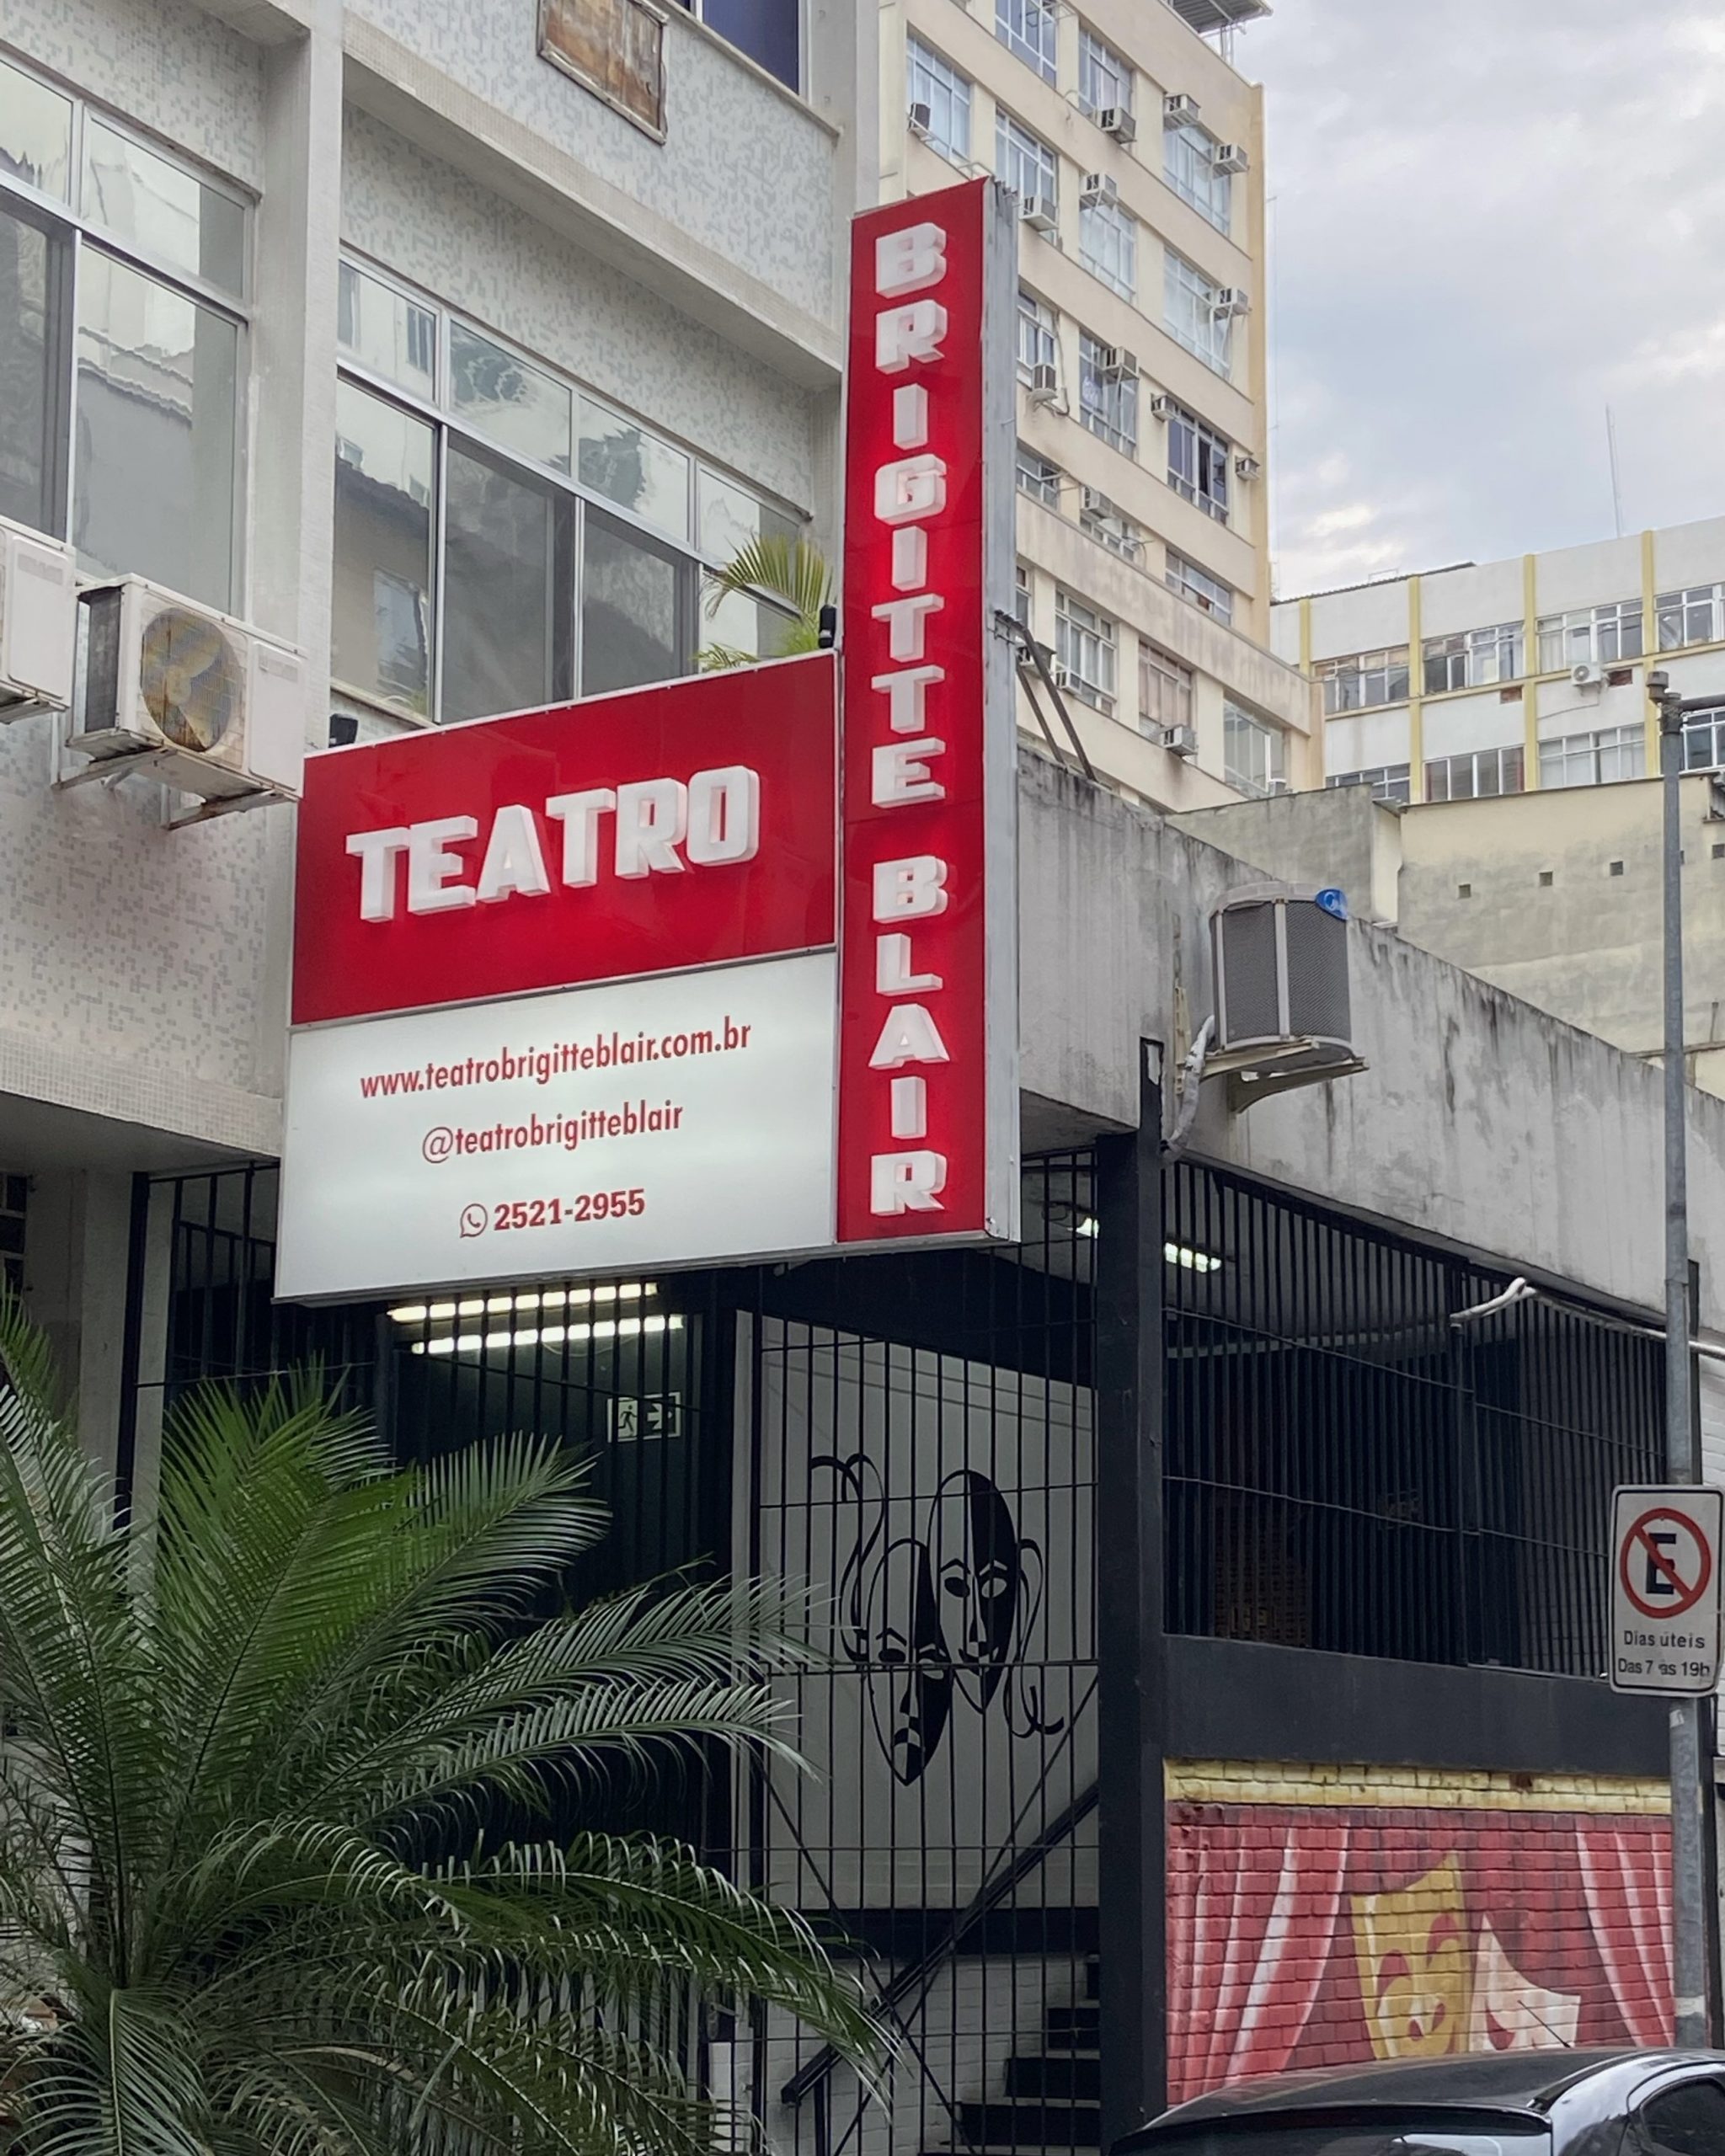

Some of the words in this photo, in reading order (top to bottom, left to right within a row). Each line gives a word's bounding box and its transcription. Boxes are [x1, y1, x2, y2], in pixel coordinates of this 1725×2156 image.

[872, 222, 948, 808] BRIGITTE
[345, 765, 761, 923] TEATRO
[360, 1015, 752, 1098] www.teatrobrigitteblair.com.br
[868, 855, 950, 1215] BLAIR
[421, 1100, 685, 1164] @teatrobrigitteblair
[494, 1188, 646, 1231] 2521-2955
[1646, 1533, 1676, 1594] E
[1618, 1657, 1642, 1674] Das
[1645, 1660, 1653, 1674] 7
[1681, 1661, 1710, 1677] 19h
[1624, 1630, 1655, 1646] Dias
